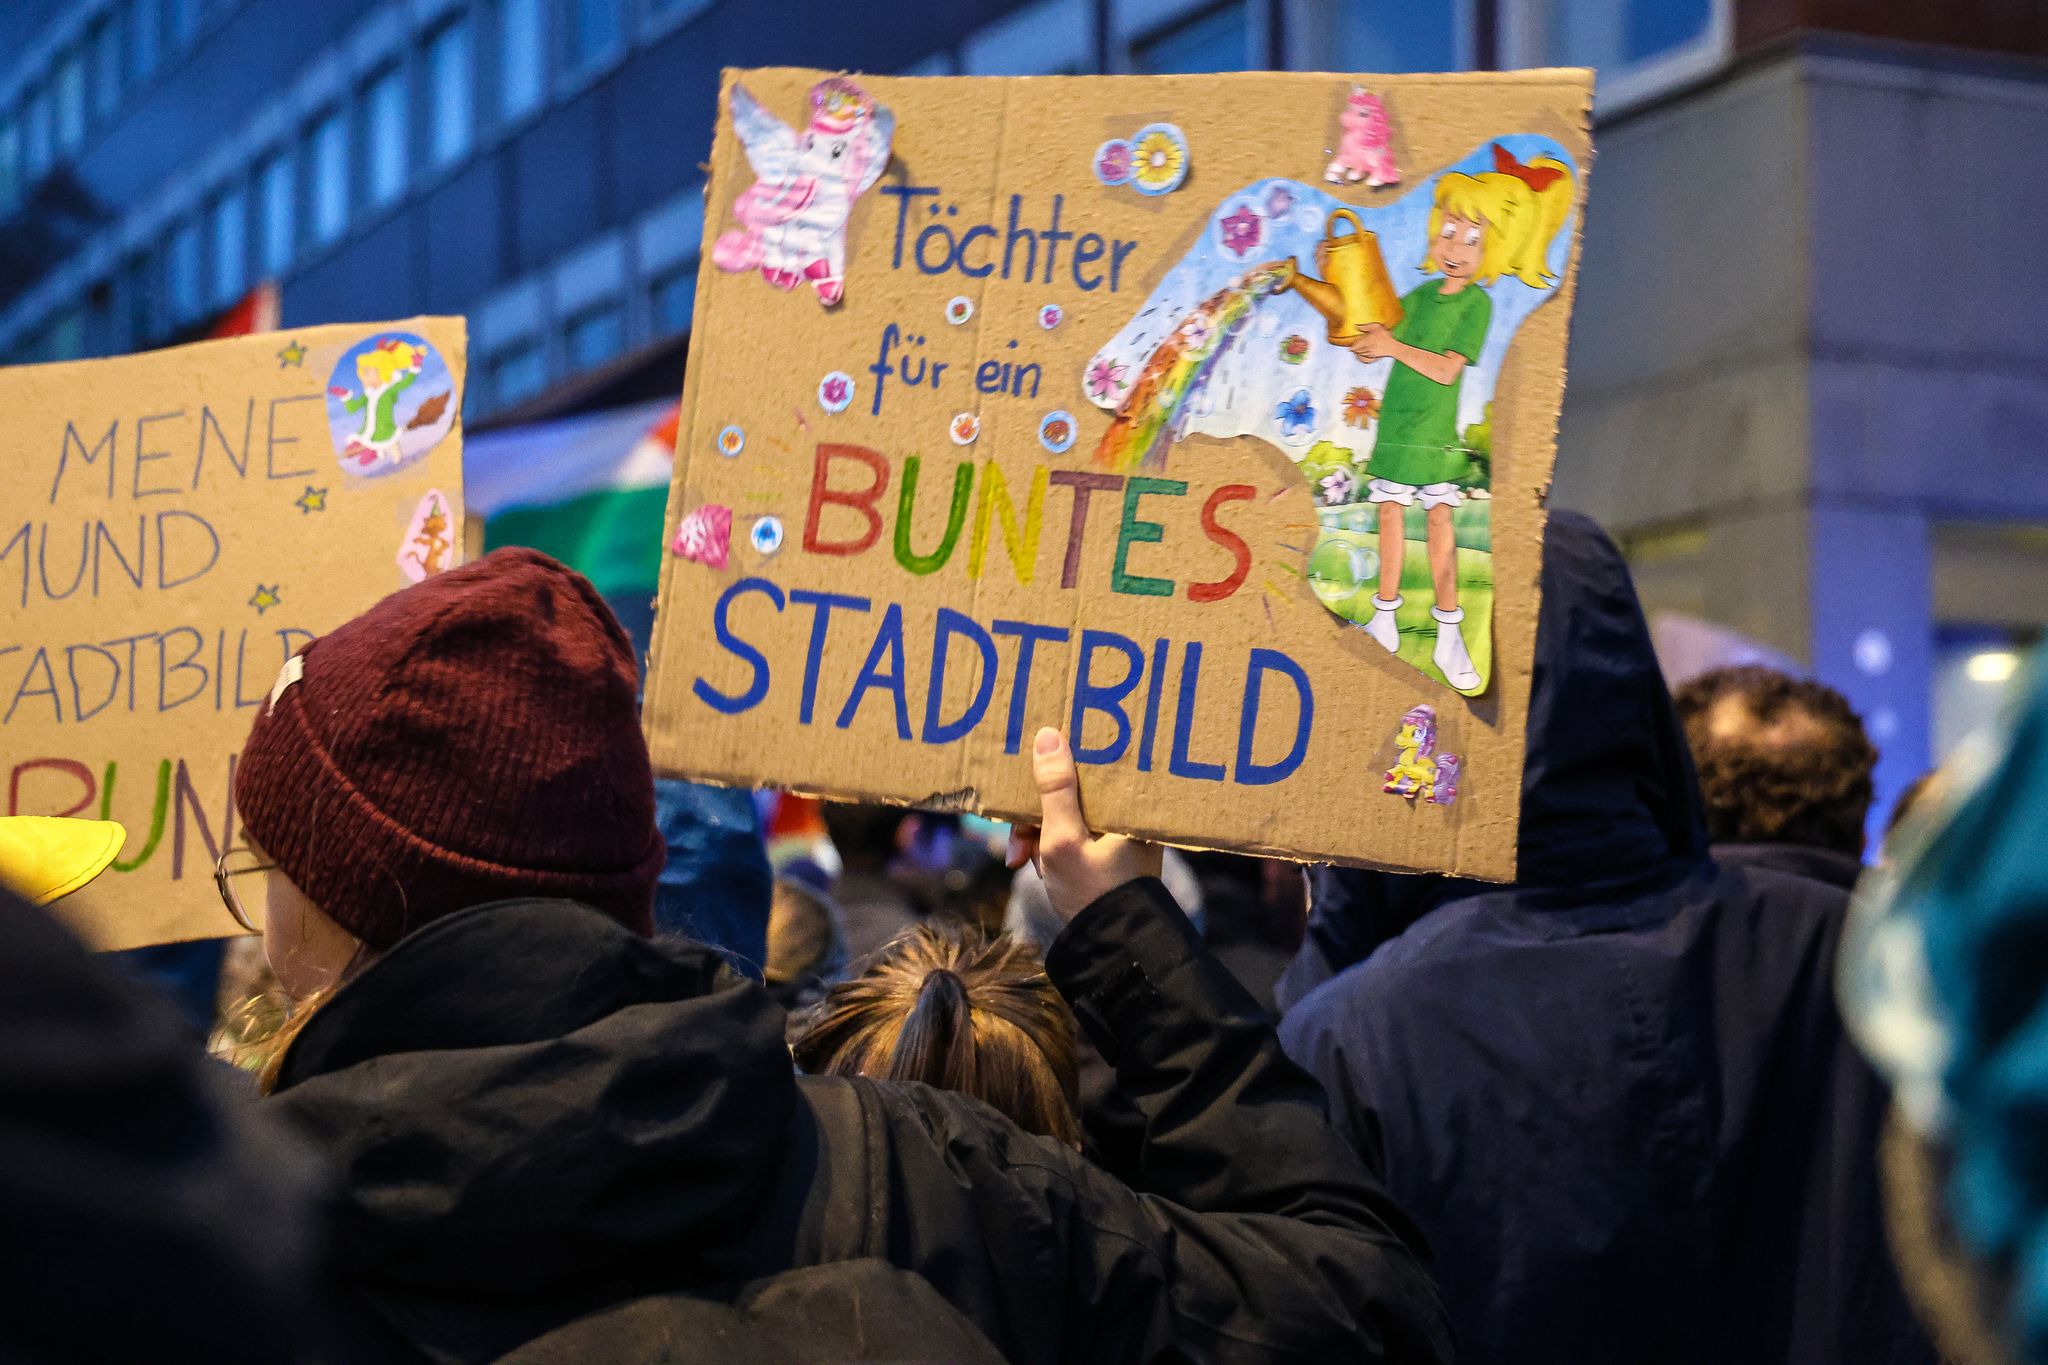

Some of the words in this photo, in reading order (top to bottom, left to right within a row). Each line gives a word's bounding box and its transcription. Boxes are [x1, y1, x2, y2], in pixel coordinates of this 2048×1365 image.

[880, 184, 1136, 292] Töchter
[869, 323, 947, 415] für
[976, 339, 1042, 398] ein
[50, 393, 325, 504] MENE
[802, 443, 1257, 603] BUNTES
[0, 626, 317, 724] ADTBIL
[692, 577, 1314, 786] STADTBILD
